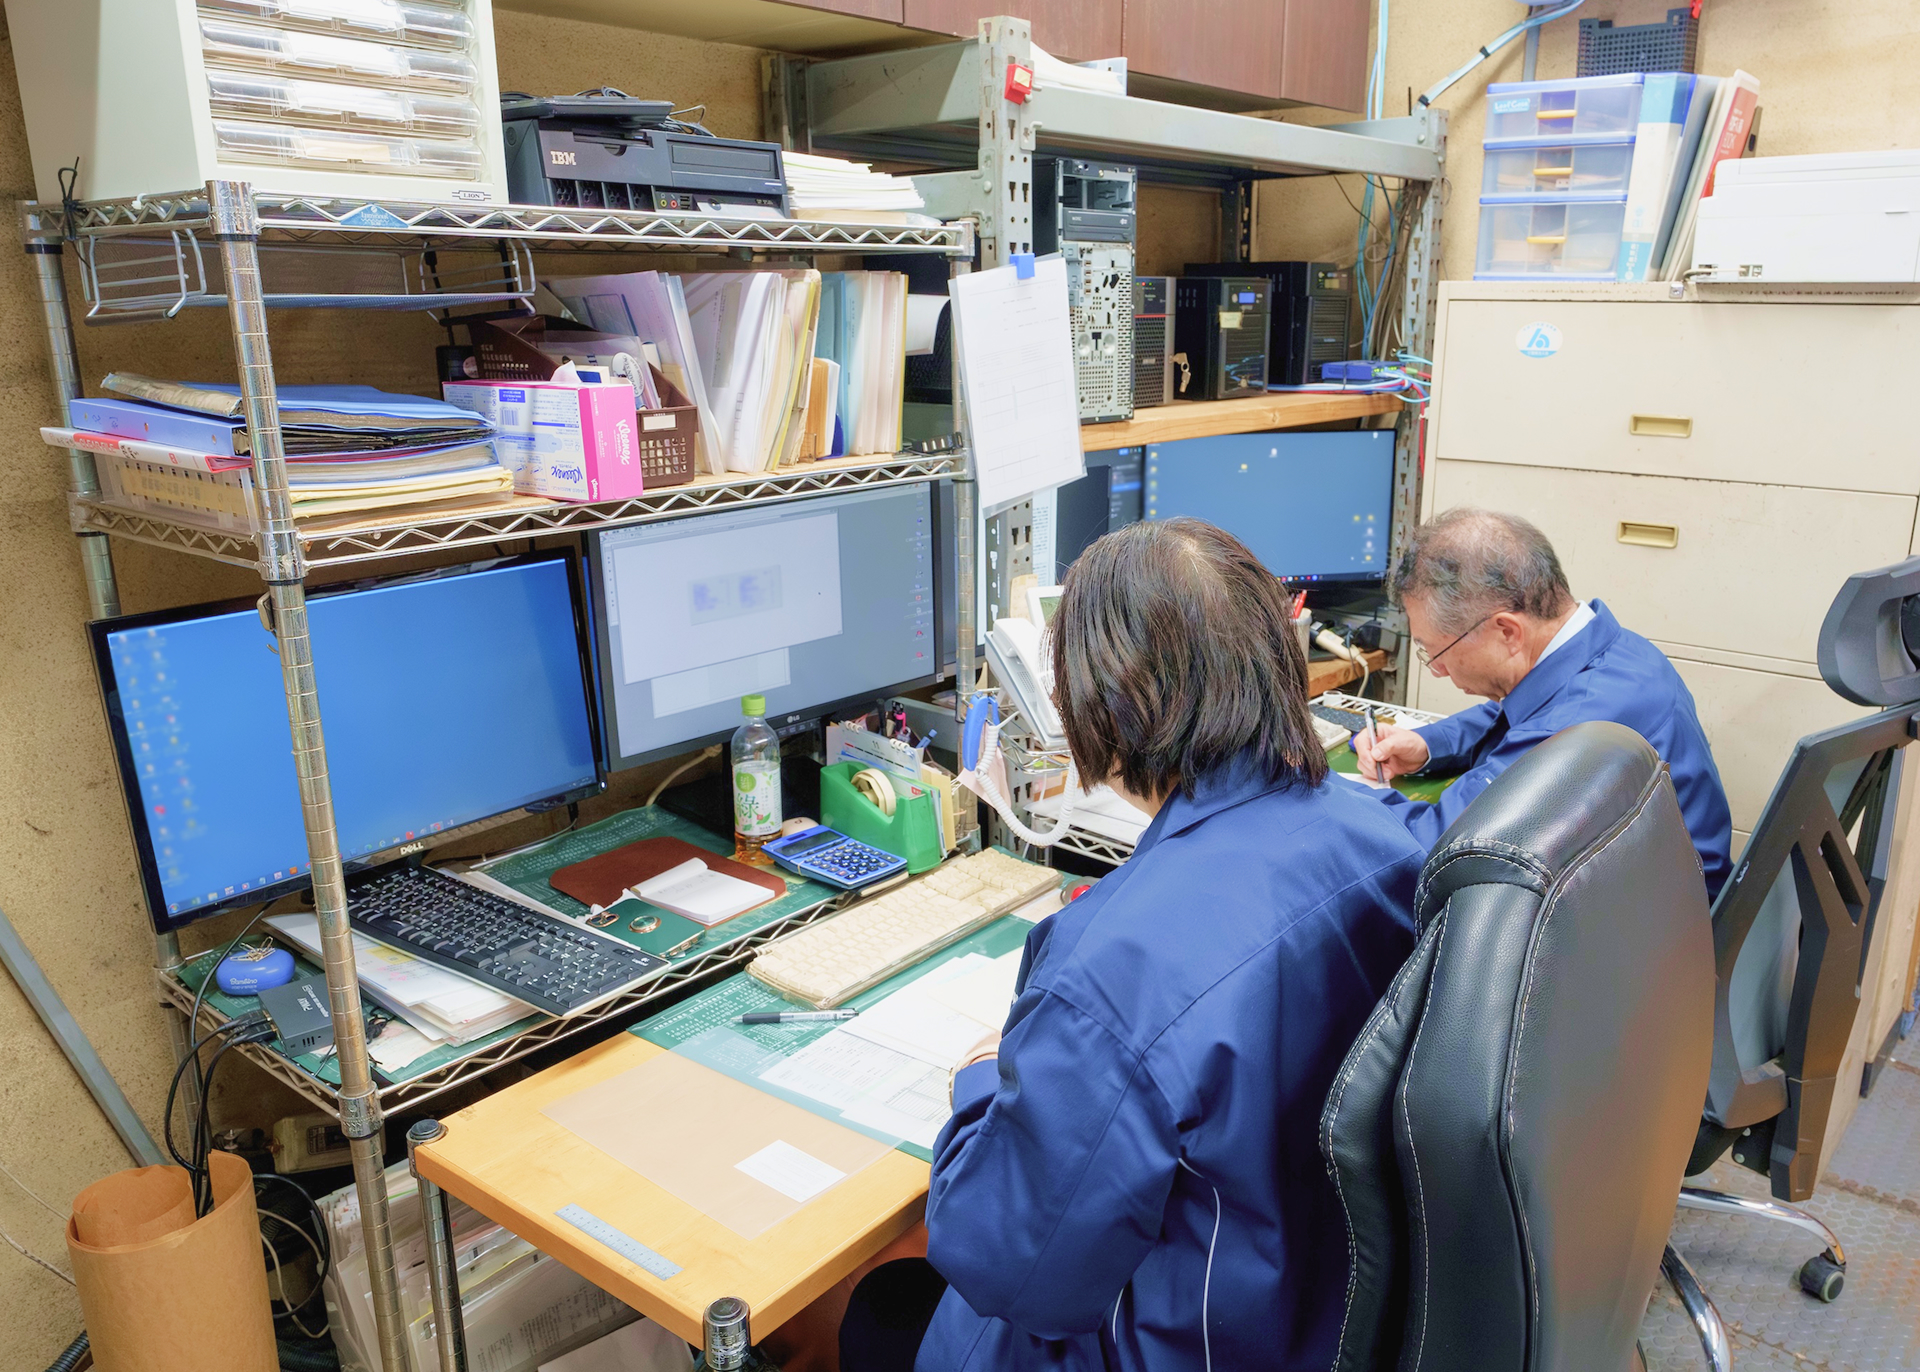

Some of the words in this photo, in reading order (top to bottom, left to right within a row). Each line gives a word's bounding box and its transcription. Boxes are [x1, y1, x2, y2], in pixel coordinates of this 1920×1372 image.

[550, 150, 577, 166] IBM
[616, 419, 631, 465] Kleenex
[550, 465, 583, 484] Kleenex
[591, 478, 599, 500] Kleenex
[400, 841, 424, 855] DELL
